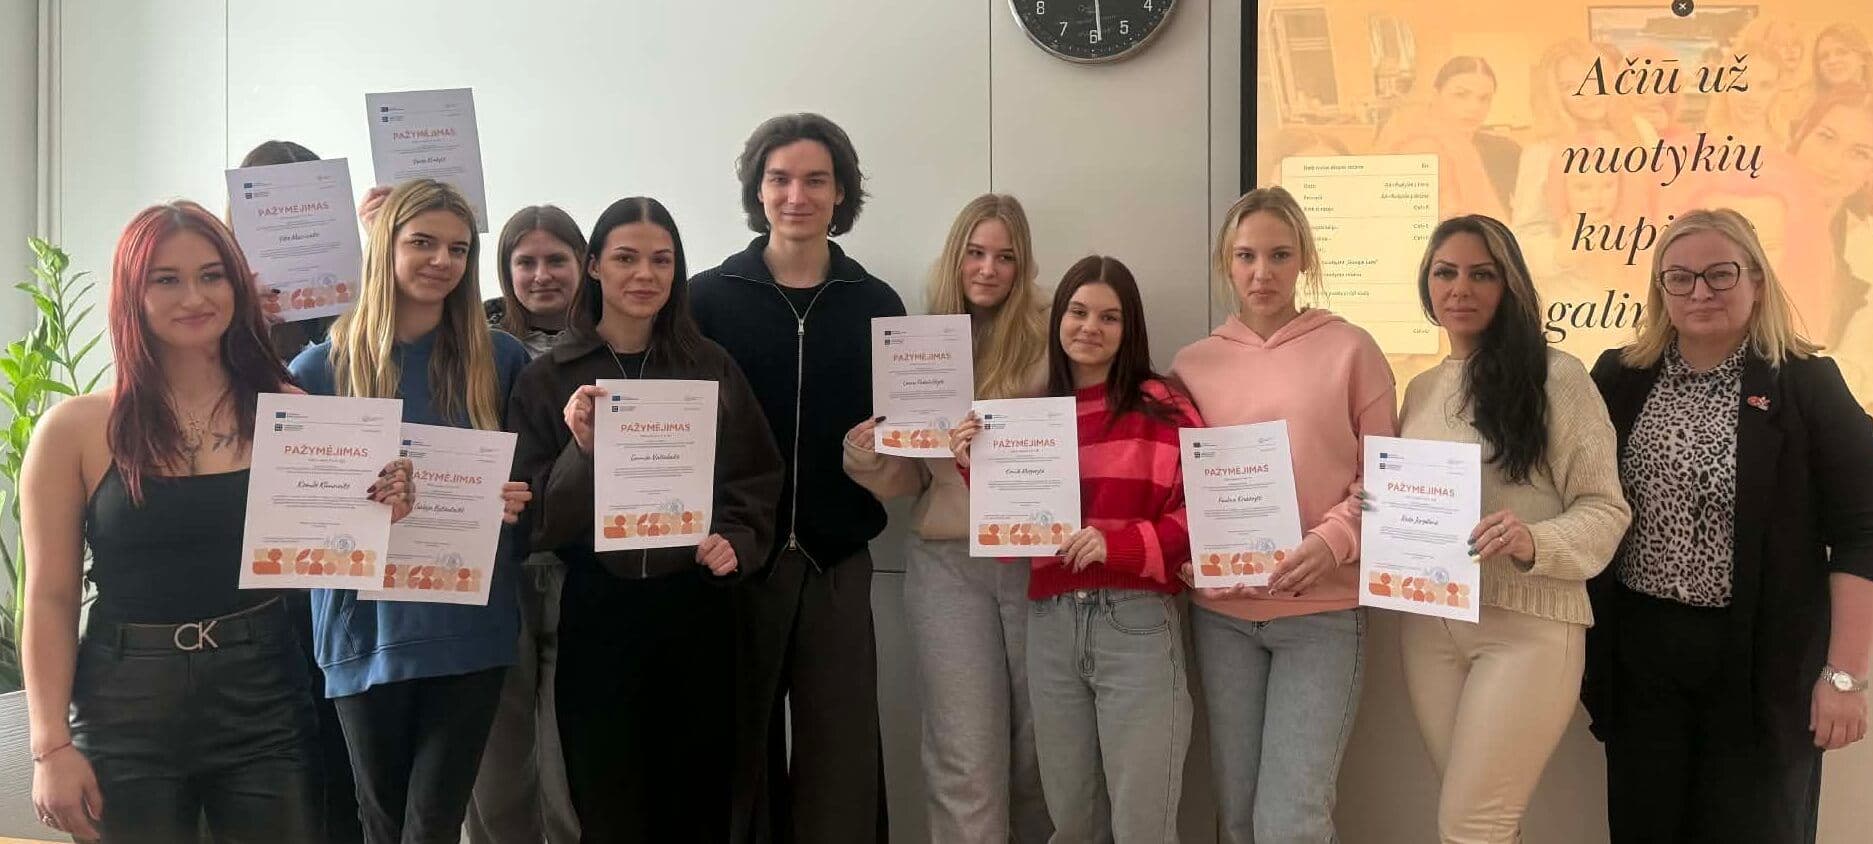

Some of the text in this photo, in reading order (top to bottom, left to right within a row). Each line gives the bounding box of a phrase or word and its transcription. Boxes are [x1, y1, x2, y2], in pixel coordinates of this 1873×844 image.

[1036, 1, 1045, 14] 8
[1143, 0, 1153, 11] 4
[1059, 21, 1068, 36] 7
[1120, 20, 1129, 34] 5
[1089, 29, 1098, 43] 6
[1571, 53, 1749, 97] Ačiū už
[1561, 132, 1764, 187] nuotykių
[620, 421, 691, 433] PAŽYMĖJIMAS
[993, 437, 1056, 448] PAŽYMĖJIMAS
[284, 445, 369, 458] PAŽYMĖJIMAS
[1204, 463, 1269, 477] PAŽYMĖJIMAS
[413, 470, 483, 485] AŽYMĖJIMAS
[1387, 481, 1455, 498] PAŽYMĖJIMAS
[174, 620, 218, 650] CK
